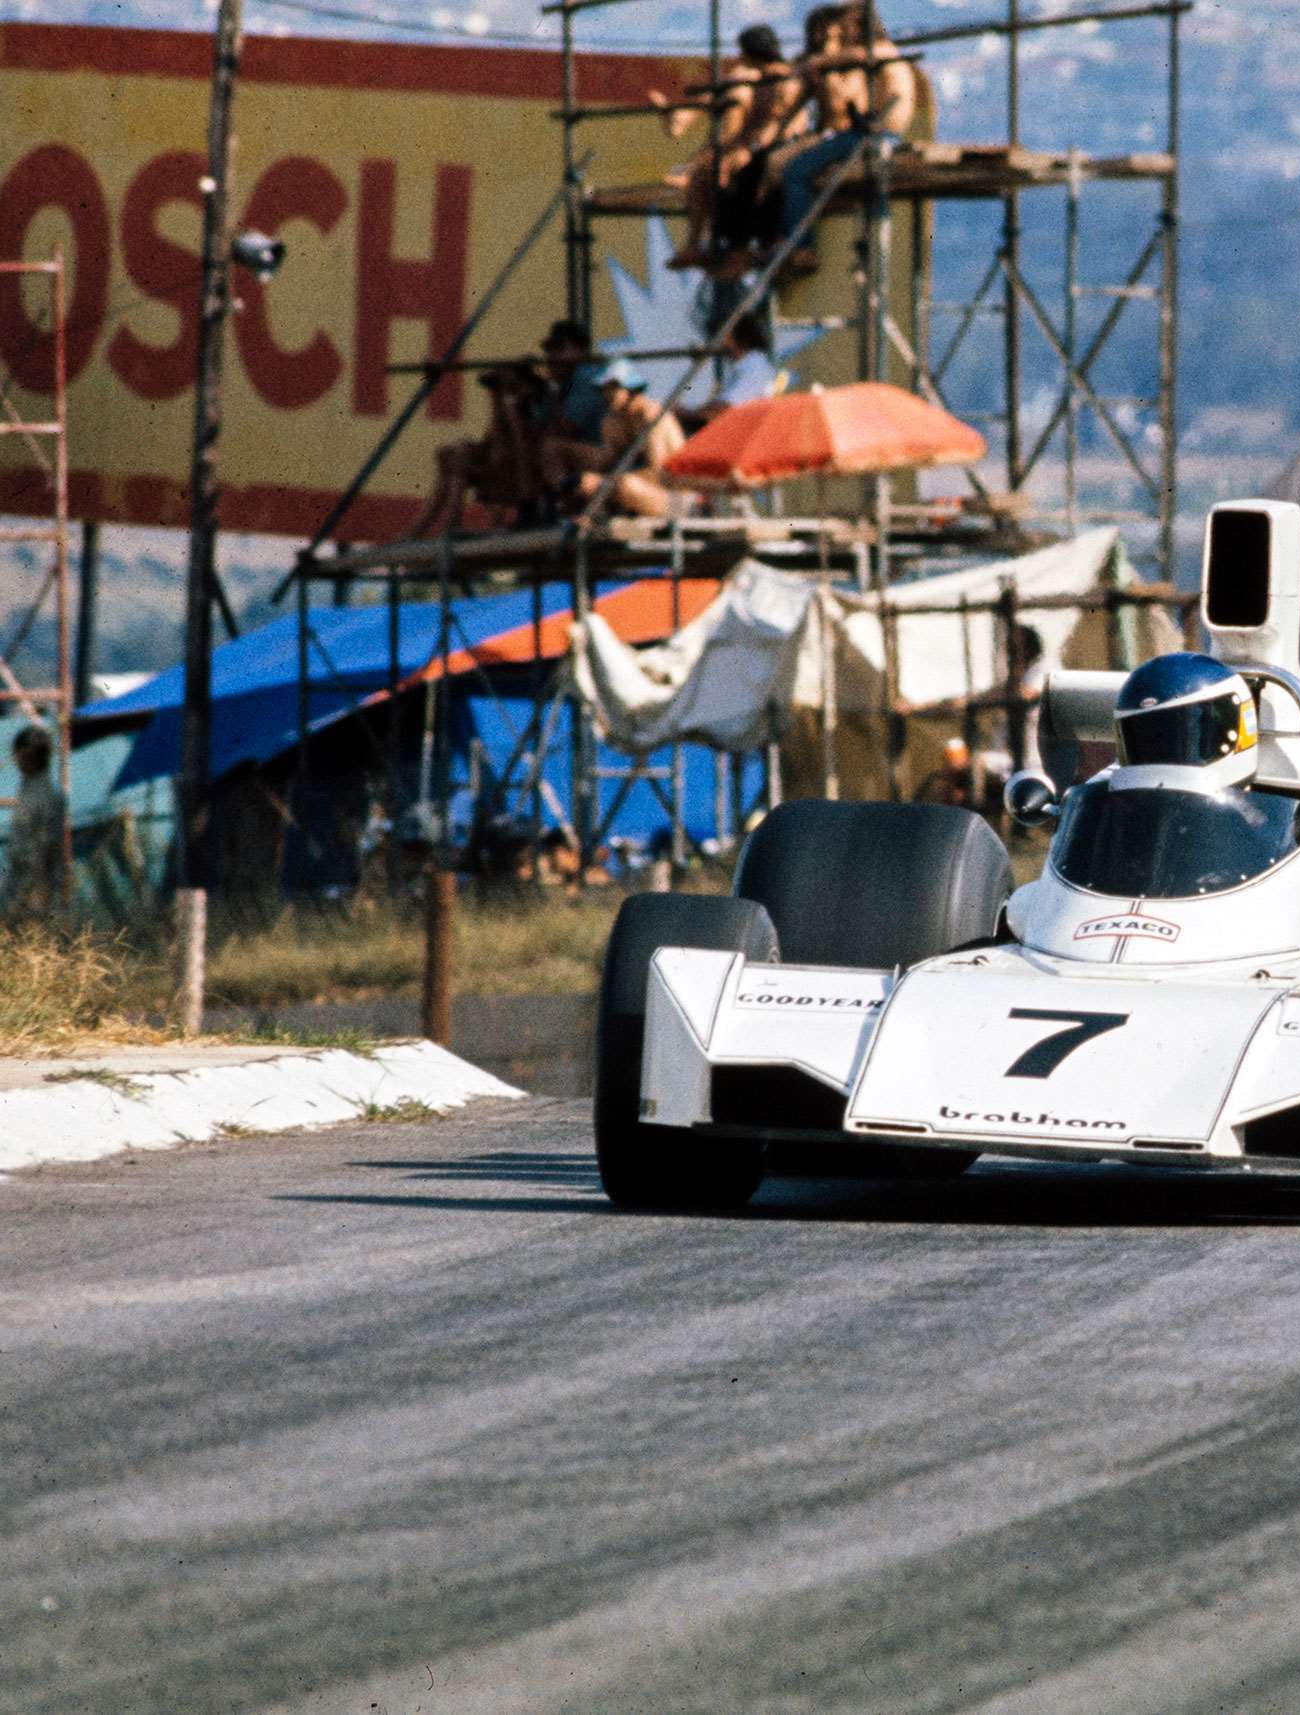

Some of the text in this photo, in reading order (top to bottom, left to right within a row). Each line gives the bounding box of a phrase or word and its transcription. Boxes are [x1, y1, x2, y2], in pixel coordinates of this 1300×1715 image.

[1082, 921, 1174, 936] TEXACO
[738, 994, 885, 1009] GOODYEAR
[1003, 1007, 1131, 1079] 7
[939, 1106, 1127, 1130] brabham
